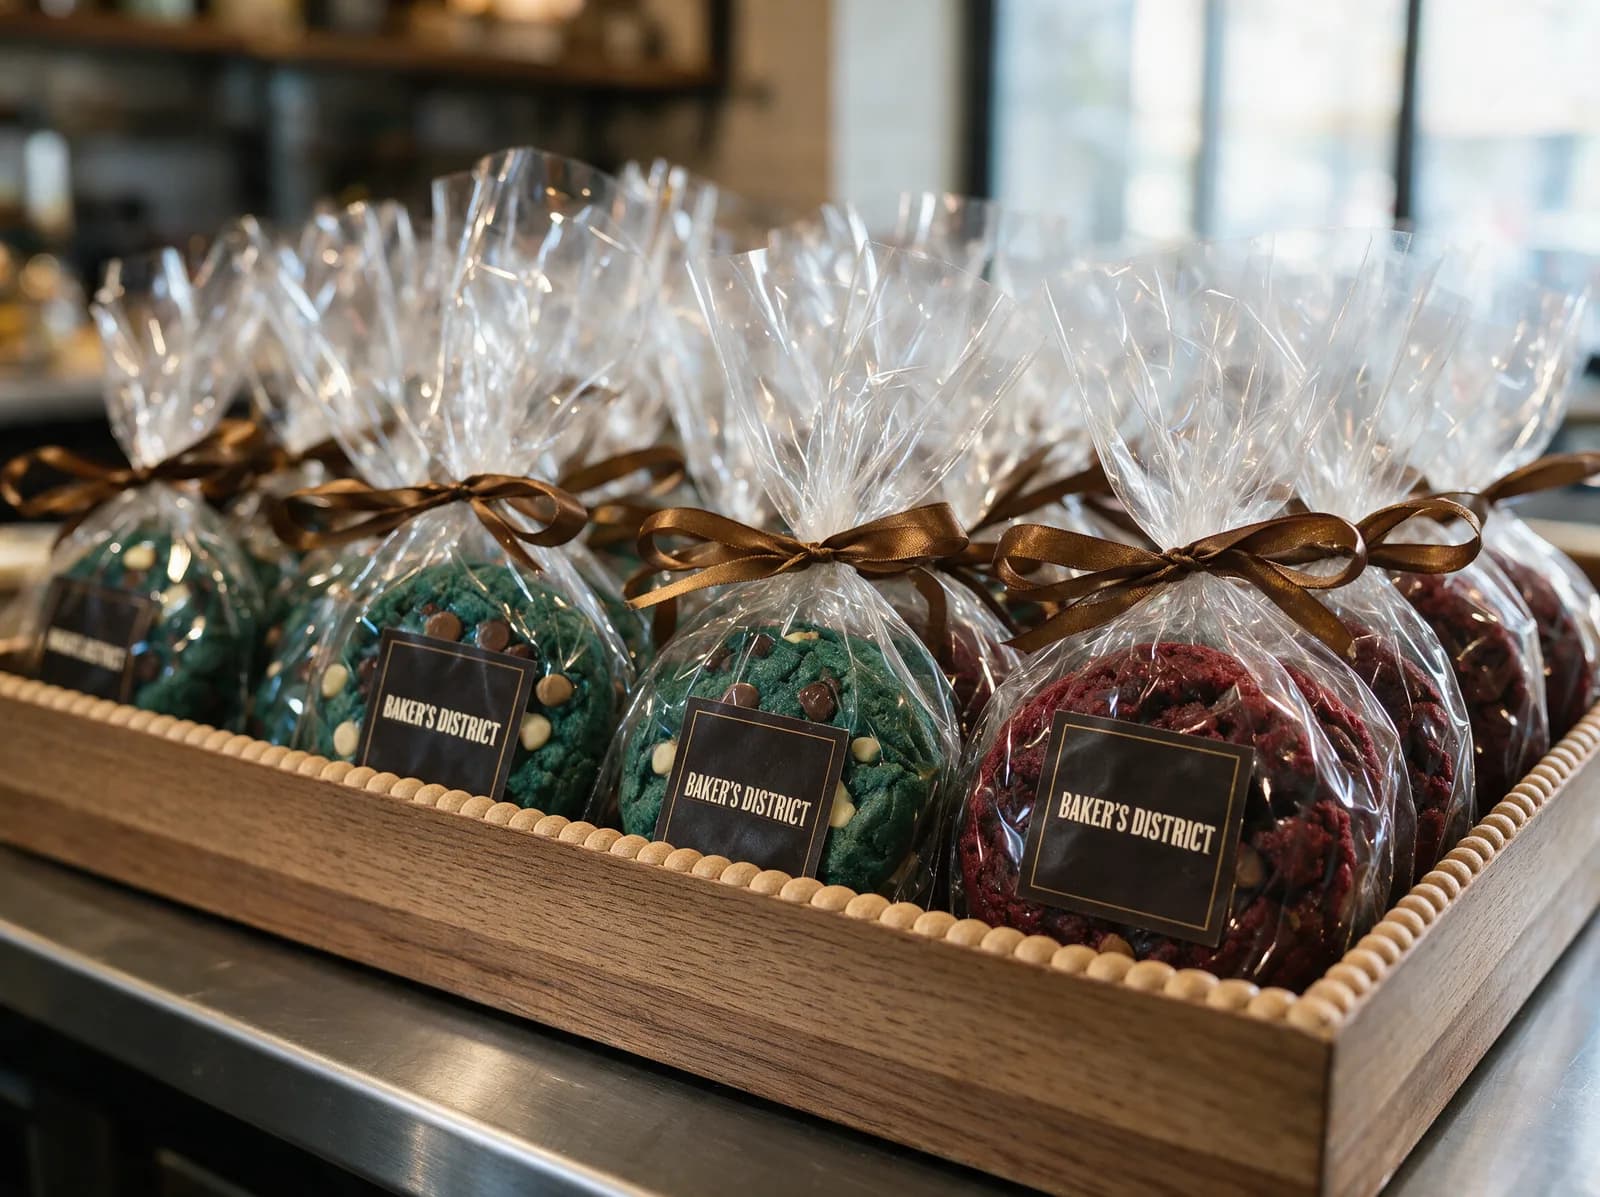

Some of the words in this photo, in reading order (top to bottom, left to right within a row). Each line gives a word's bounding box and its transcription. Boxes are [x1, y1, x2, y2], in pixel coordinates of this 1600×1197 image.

[382, 694, 436, 729] BAKER'S
[436, 708, 501, 746] DISTRICT
[684, 772, 741, 808] BAKER'S
[741, 786, 812, 827] DISTRICT
[1058, 791, 1129, 832] BAKER'S
[1130, 808, 1216, 855] DISTRICT
